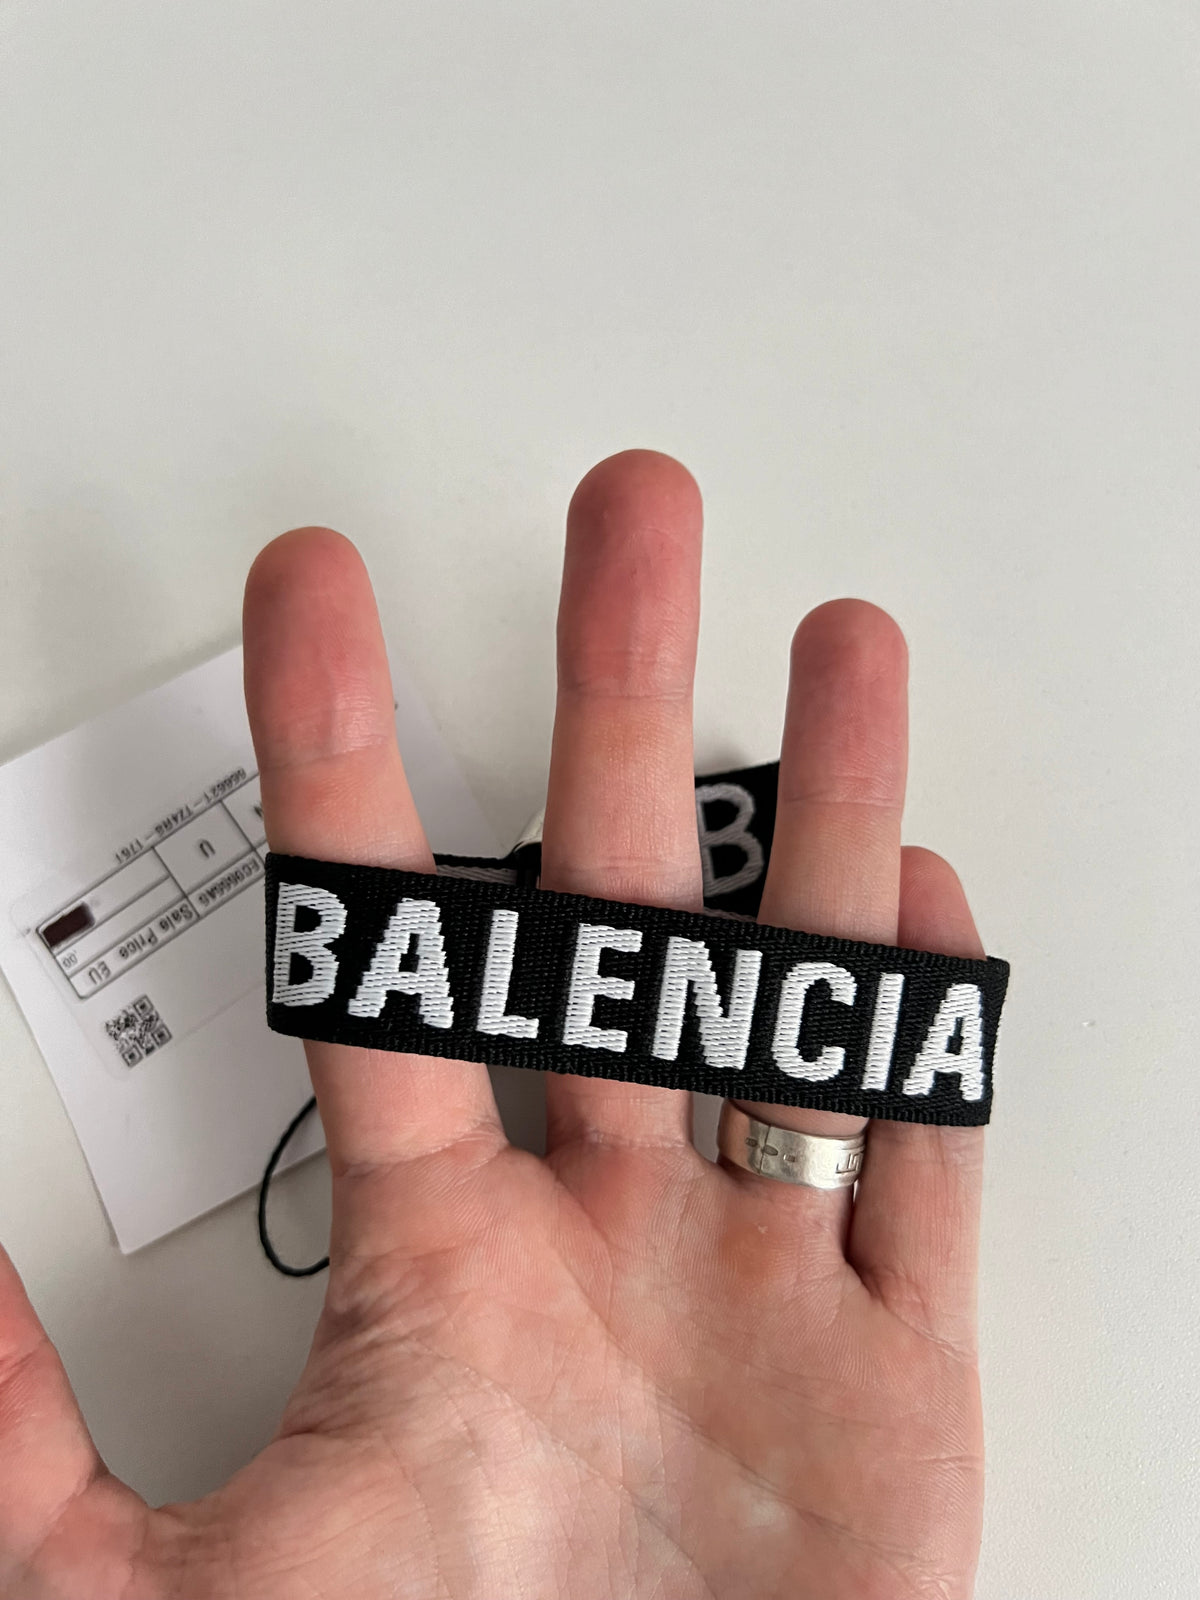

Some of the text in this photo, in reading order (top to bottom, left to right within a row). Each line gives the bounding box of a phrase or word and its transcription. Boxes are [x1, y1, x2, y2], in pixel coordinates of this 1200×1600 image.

[88, 903, 194, 985] Sale Price EU
[272, 881, 985, 1101] BALENCIA
